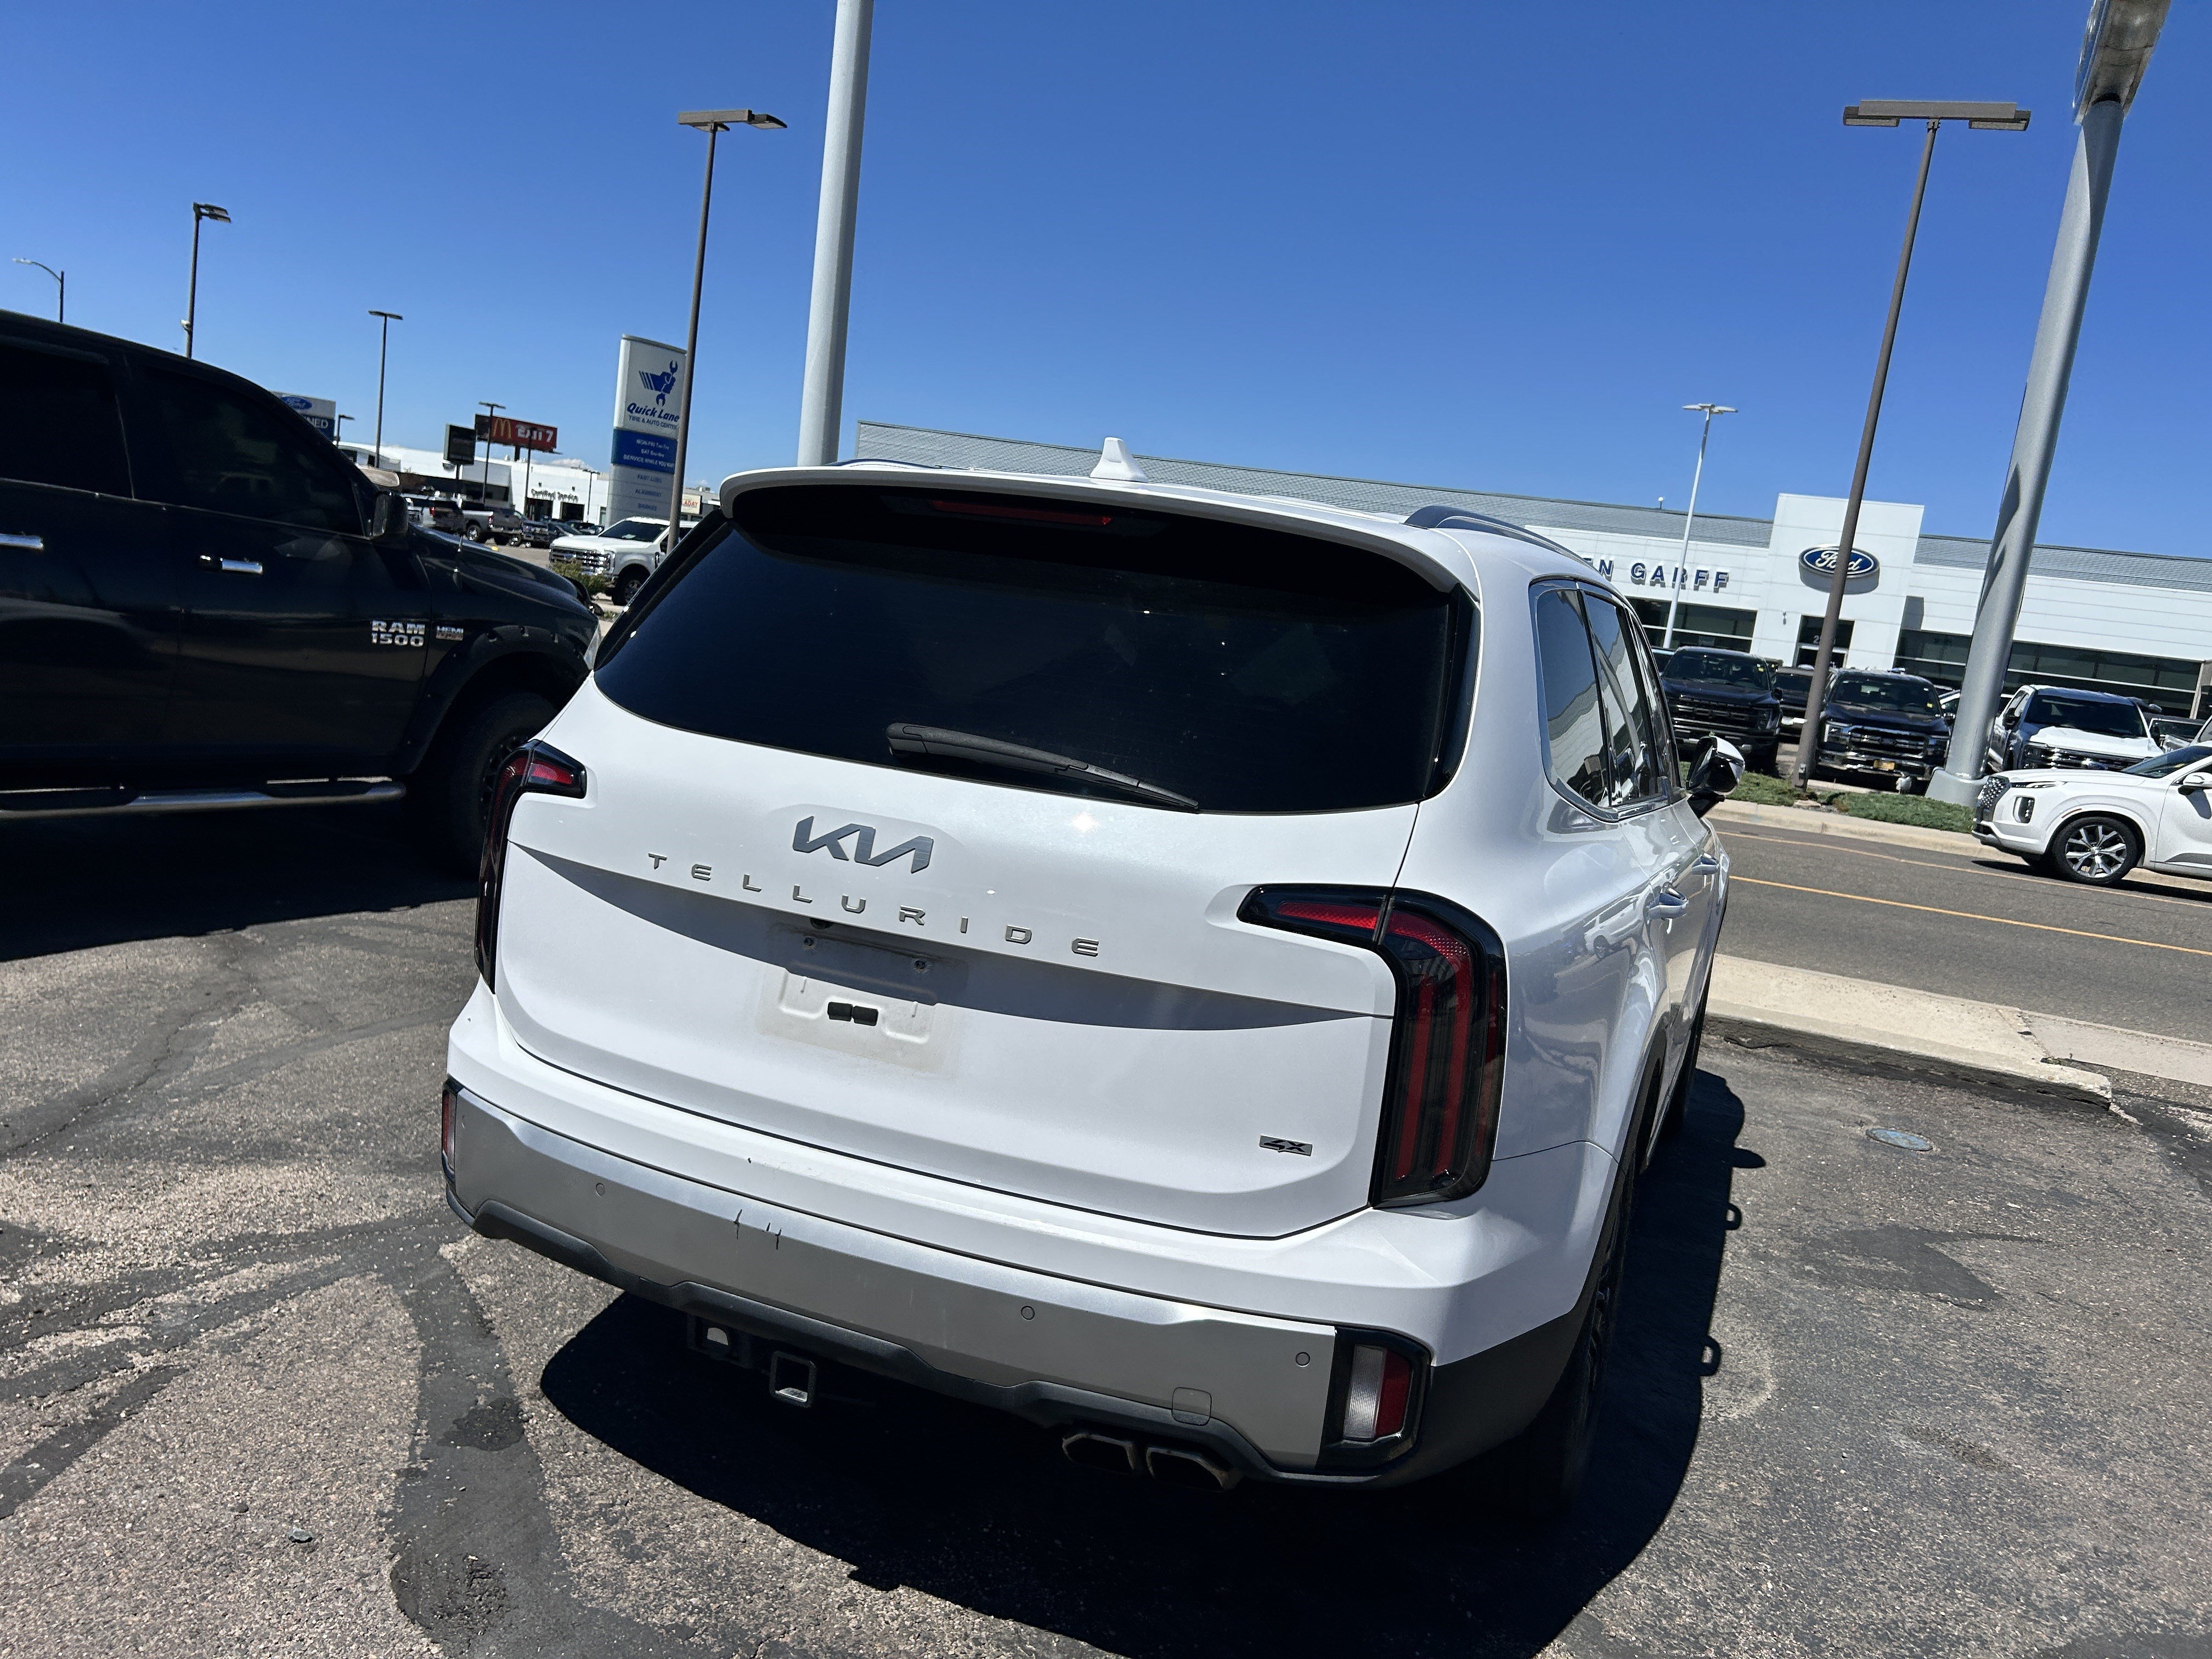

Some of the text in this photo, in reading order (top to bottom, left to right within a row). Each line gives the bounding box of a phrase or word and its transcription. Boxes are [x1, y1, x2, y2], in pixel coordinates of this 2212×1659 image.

[627, 403, 680, 422] Quick Lane
[545, 430, 554, 443] 7
[623, 454, 644, 462] SERVICE
[1815, 550, 1863, 572] Fod
[1631, 562, 1729, 590] GARFF
[372, 620, 425, 635] RAM
[371, 632, 425, 647] 1500
[792, 815, 934, 874] KIA
[648, 852, 1099, 957] TELLURIDE
